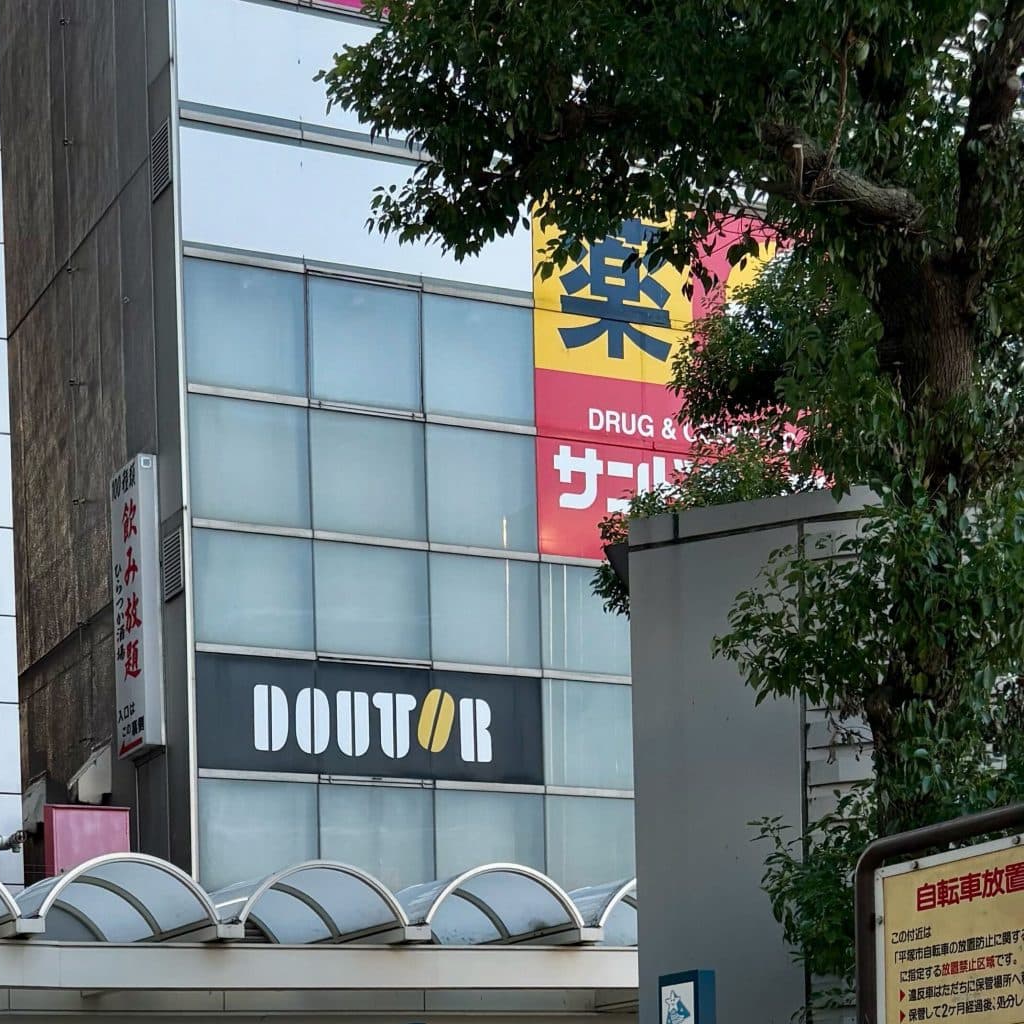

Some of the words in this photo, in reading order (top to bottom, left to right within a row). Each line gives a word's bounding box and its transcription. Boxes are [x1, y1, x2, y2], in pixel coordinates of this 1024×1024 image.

[588, 407, 655, 438] DRUG
[660, 417, 677, 440] &
[122, 498, 143, 682] 飲み放題
[253, 684, 493, 763] DOUTOR
[917, 861, 1024, 912] 自転車放置
[891, 926, 931, 944] この付近は
